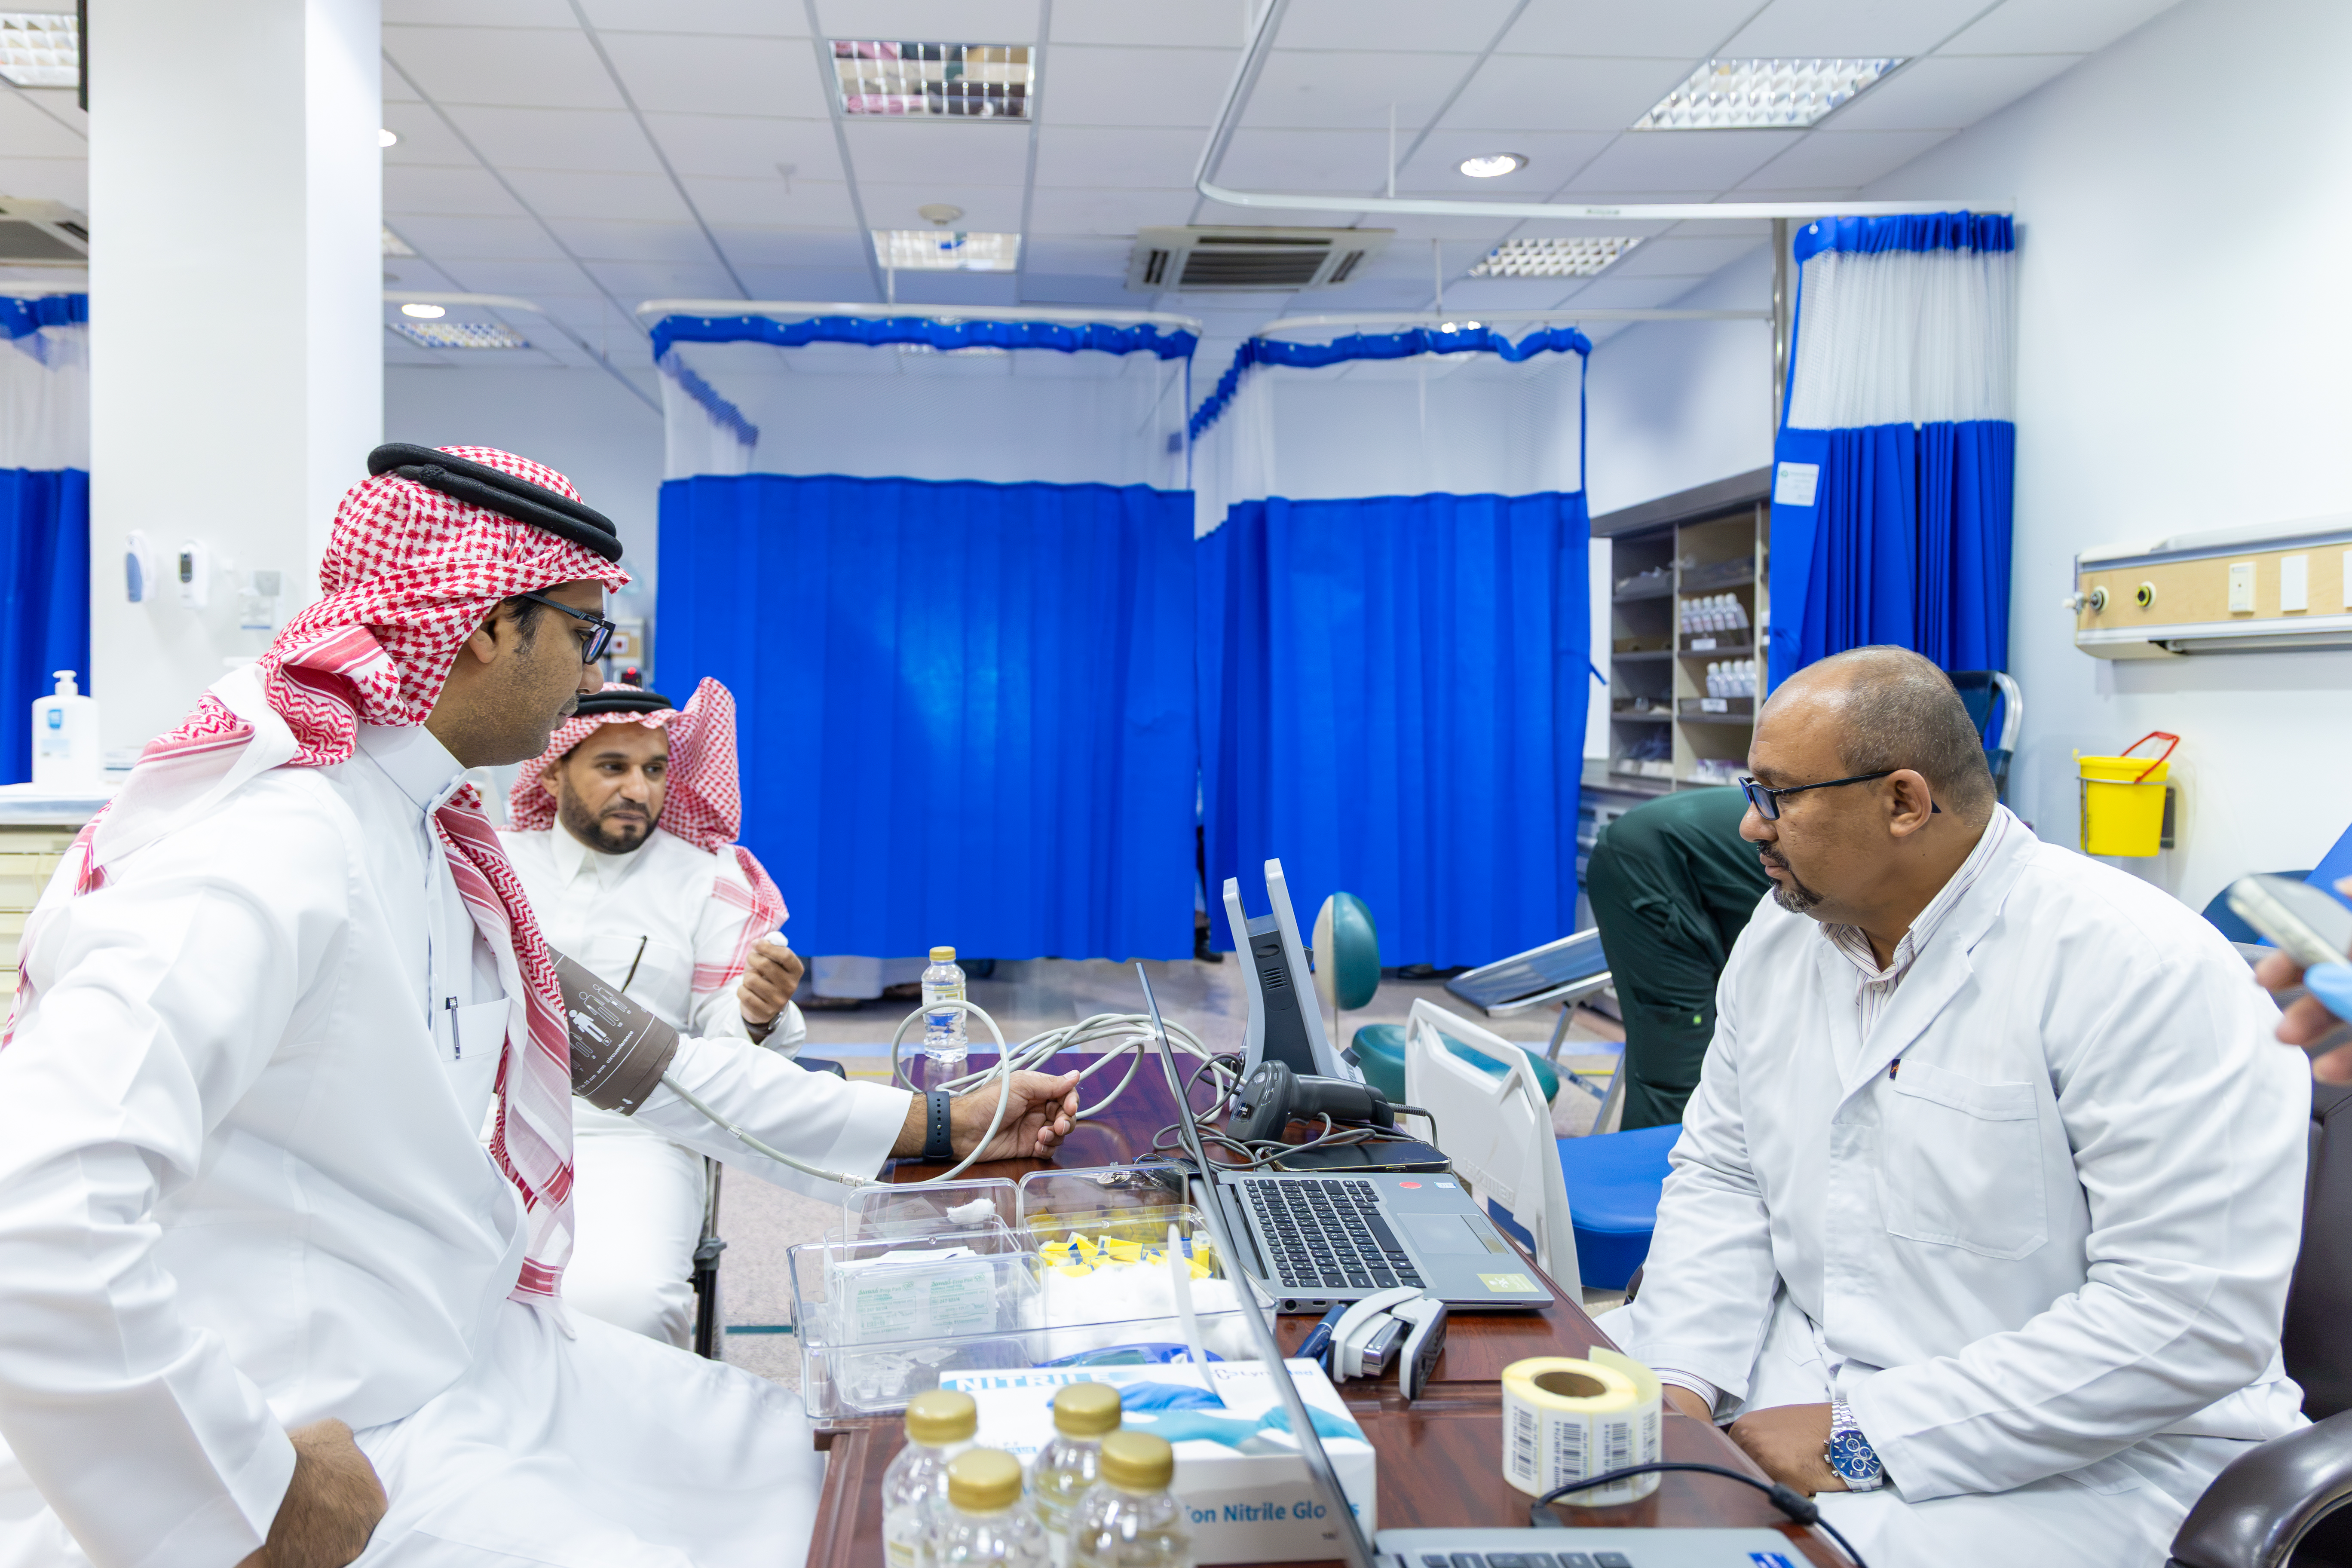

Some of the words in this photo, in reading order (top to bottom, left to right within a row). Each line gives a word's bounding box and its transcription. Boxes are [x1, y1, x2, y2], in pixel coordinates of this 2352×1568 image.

[597, 1064, 606, 1074] arm
[606, 1030, 634, 1064] circumference
[956, 1373, 1115, 1391] NITRILE
[1223, 1502, 1286, 1522] Nitrile
